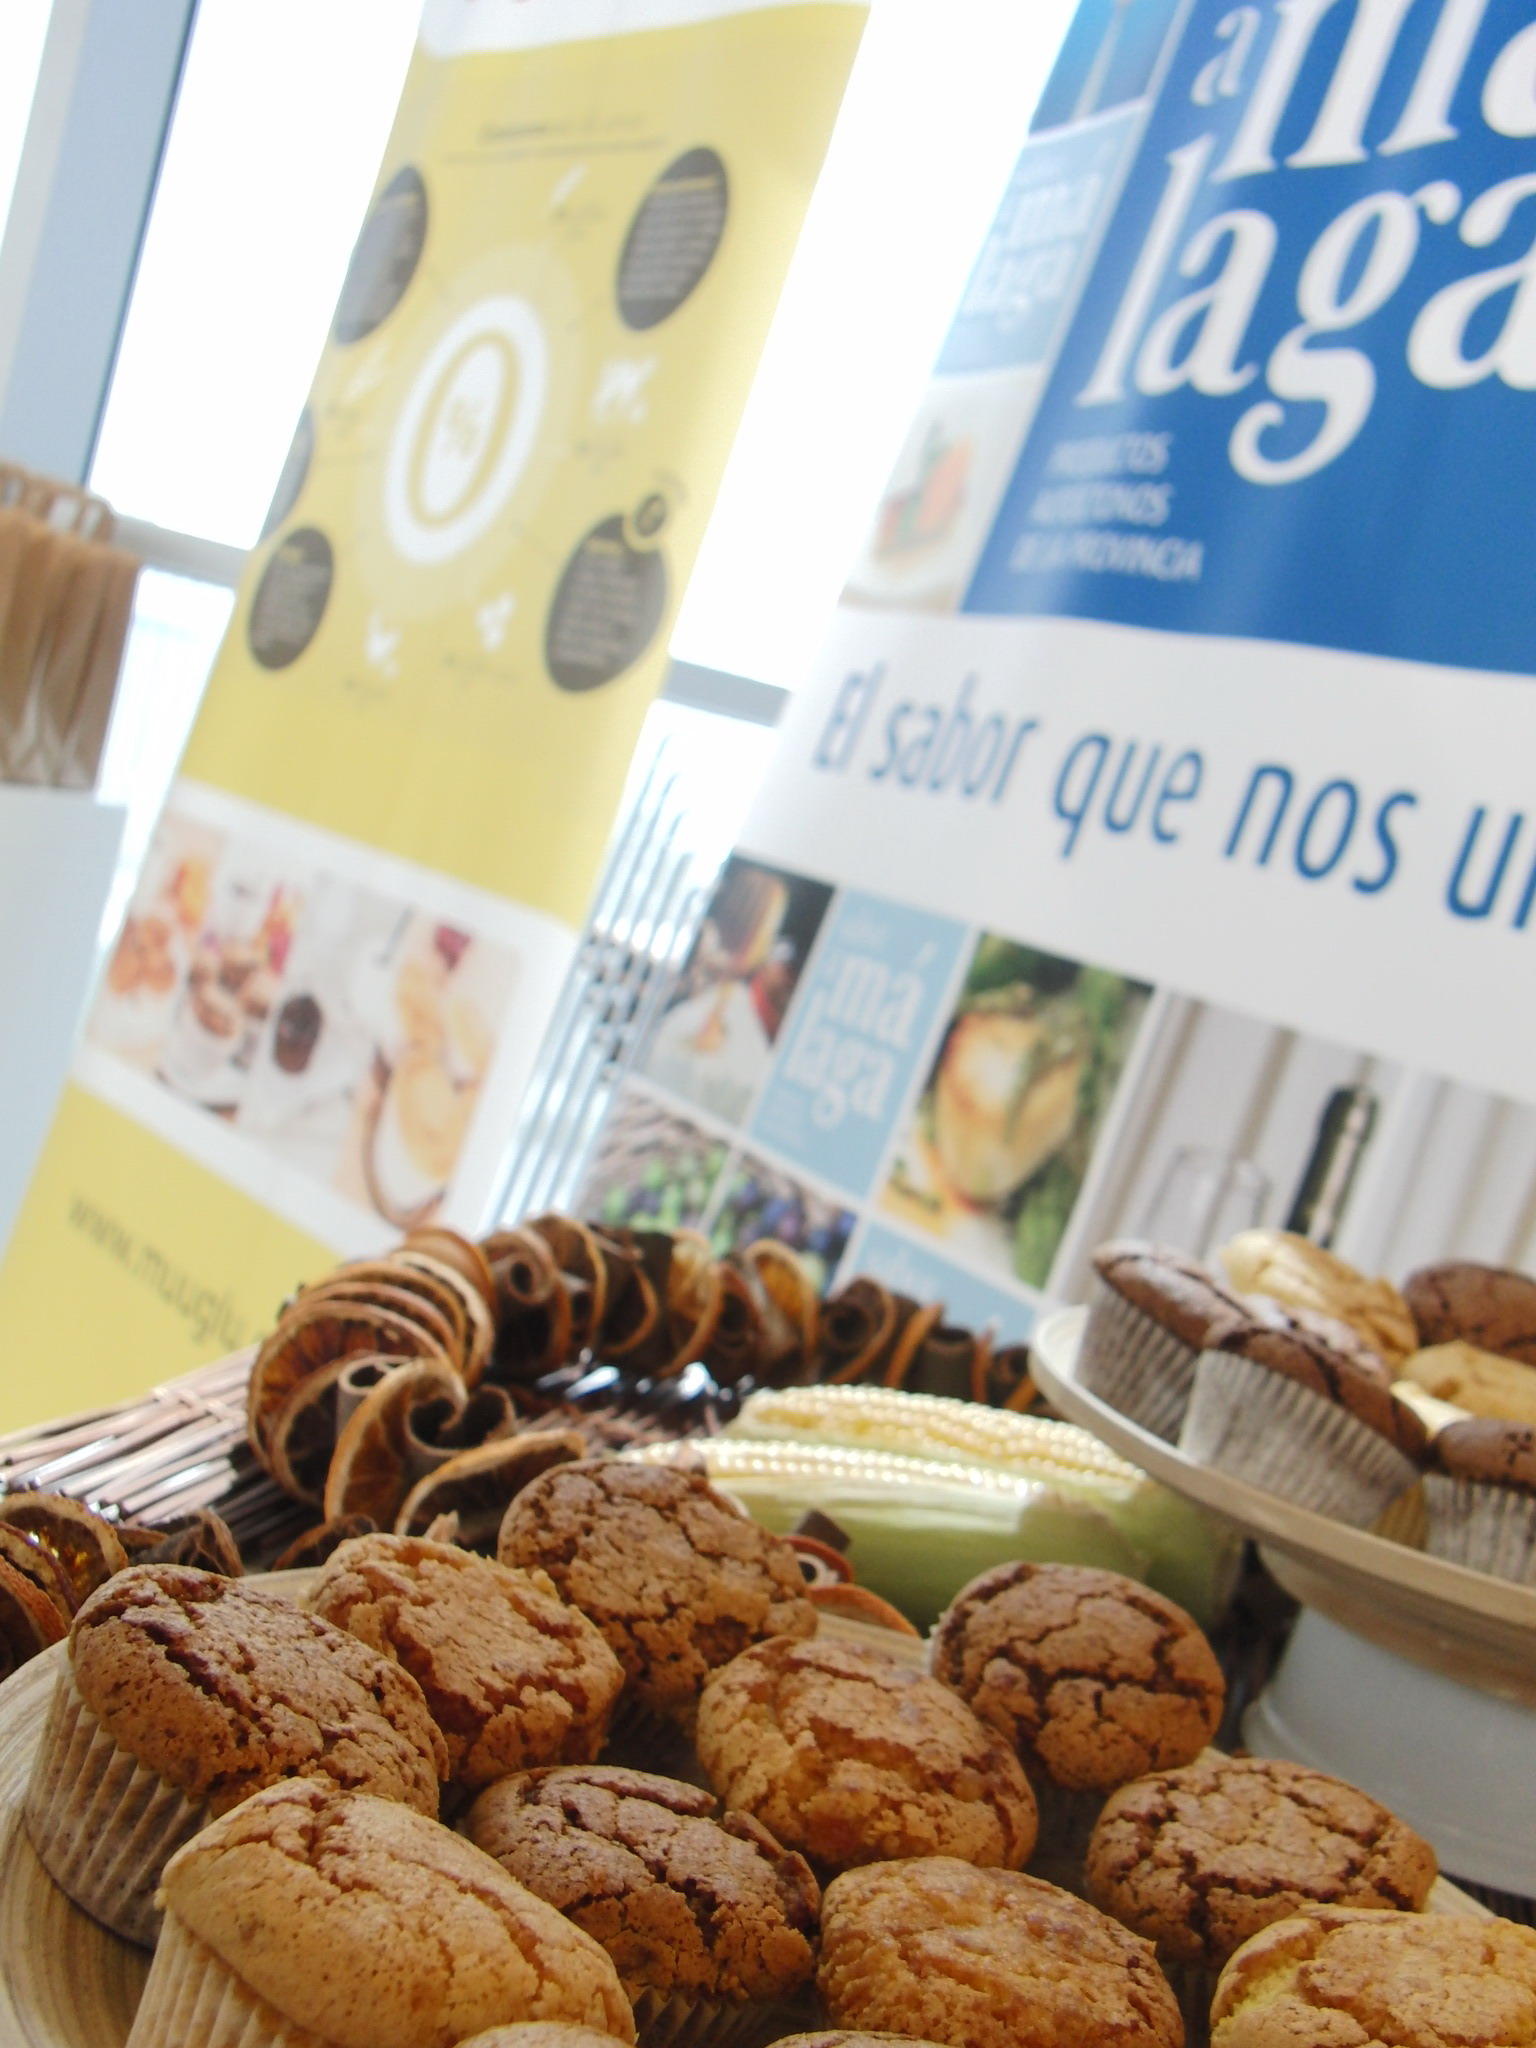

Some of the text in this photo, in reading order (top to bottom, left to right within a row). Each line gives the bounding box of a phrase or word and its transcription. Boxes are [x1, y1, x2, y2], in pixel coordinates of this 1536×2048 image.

[813, 660, 888, 772] El
[866, 670, 1040, 804] sabor
[1050, 732, 1205, 860] que
[1222, 760, 1420, 896] nos
